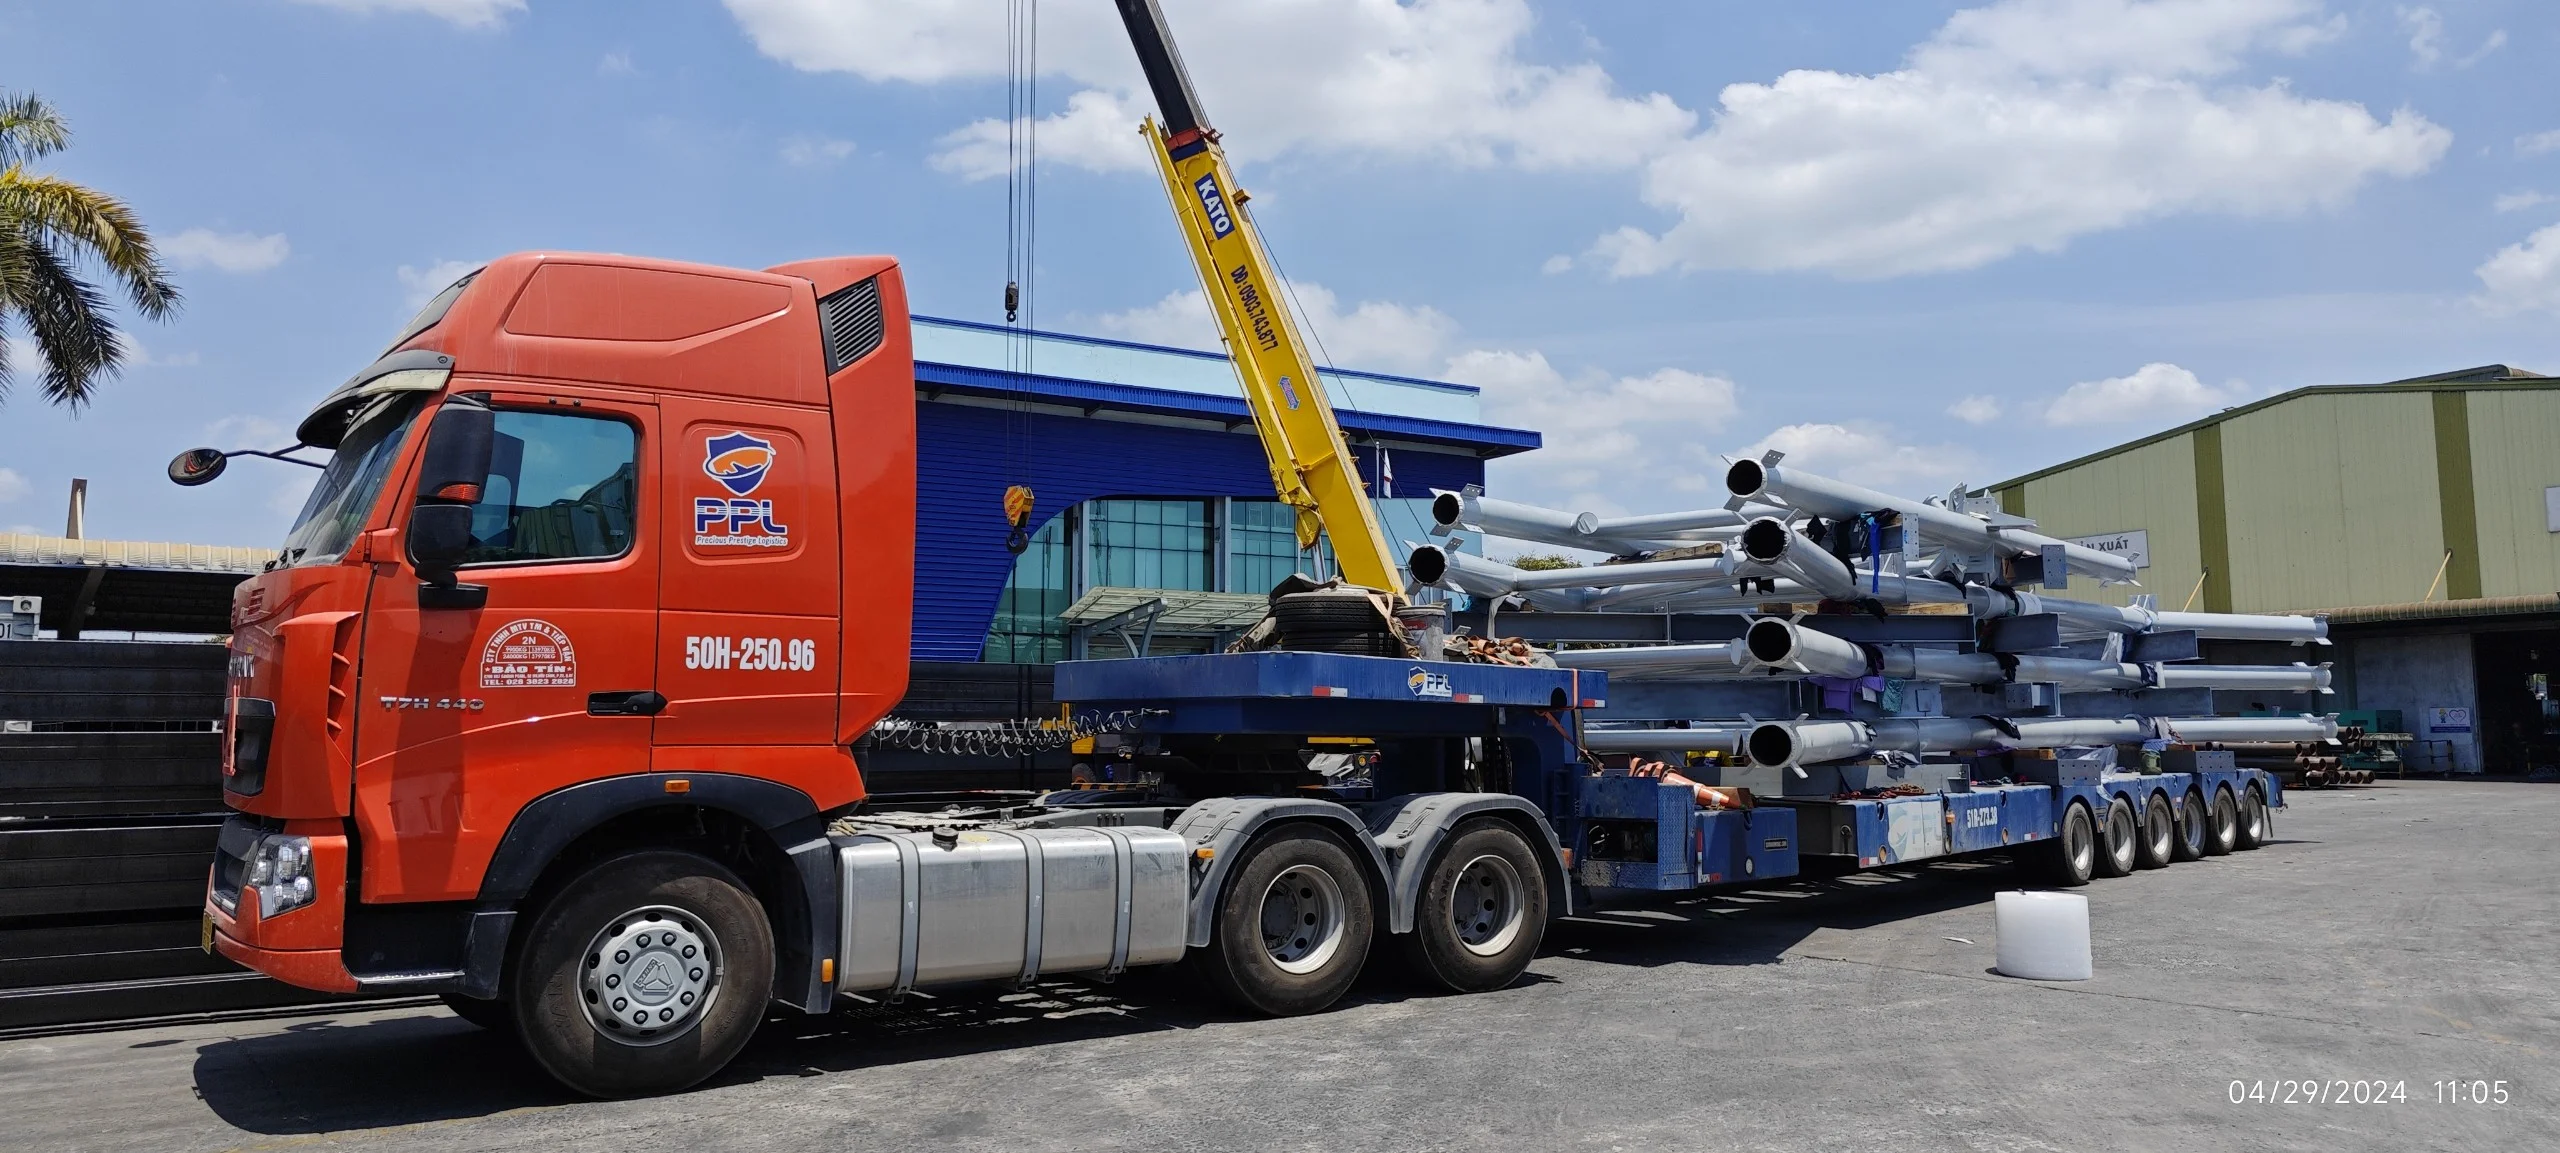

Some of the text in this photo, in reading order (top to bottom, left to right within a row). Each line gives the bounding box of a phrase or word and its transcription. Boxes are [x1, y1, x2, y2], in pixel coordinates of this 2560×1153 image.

[1198, 178, 1230, 233] KATO
[695, 498, 787, 534] PPL
[696, 536, 787, 546] Precious Prestige Logistics
[2099, 535, 2129, 552] XUẤT
[485, 648, 496, 663] CTY
[491, 630, 510, 647] TNHH
[510, 622, 528, 634] MTV
[530, 622, 542, 631] TM
[543, 626, 551, 634] &
[522, 636, 537, 645] 2N
[685, 636, 815, 671] 50H-250.96
[491, 663, 566, 674] BẢO TÍN
[1426, 674, 1451, 691] PPL
[380, 696, 485, 710] T7H 440
